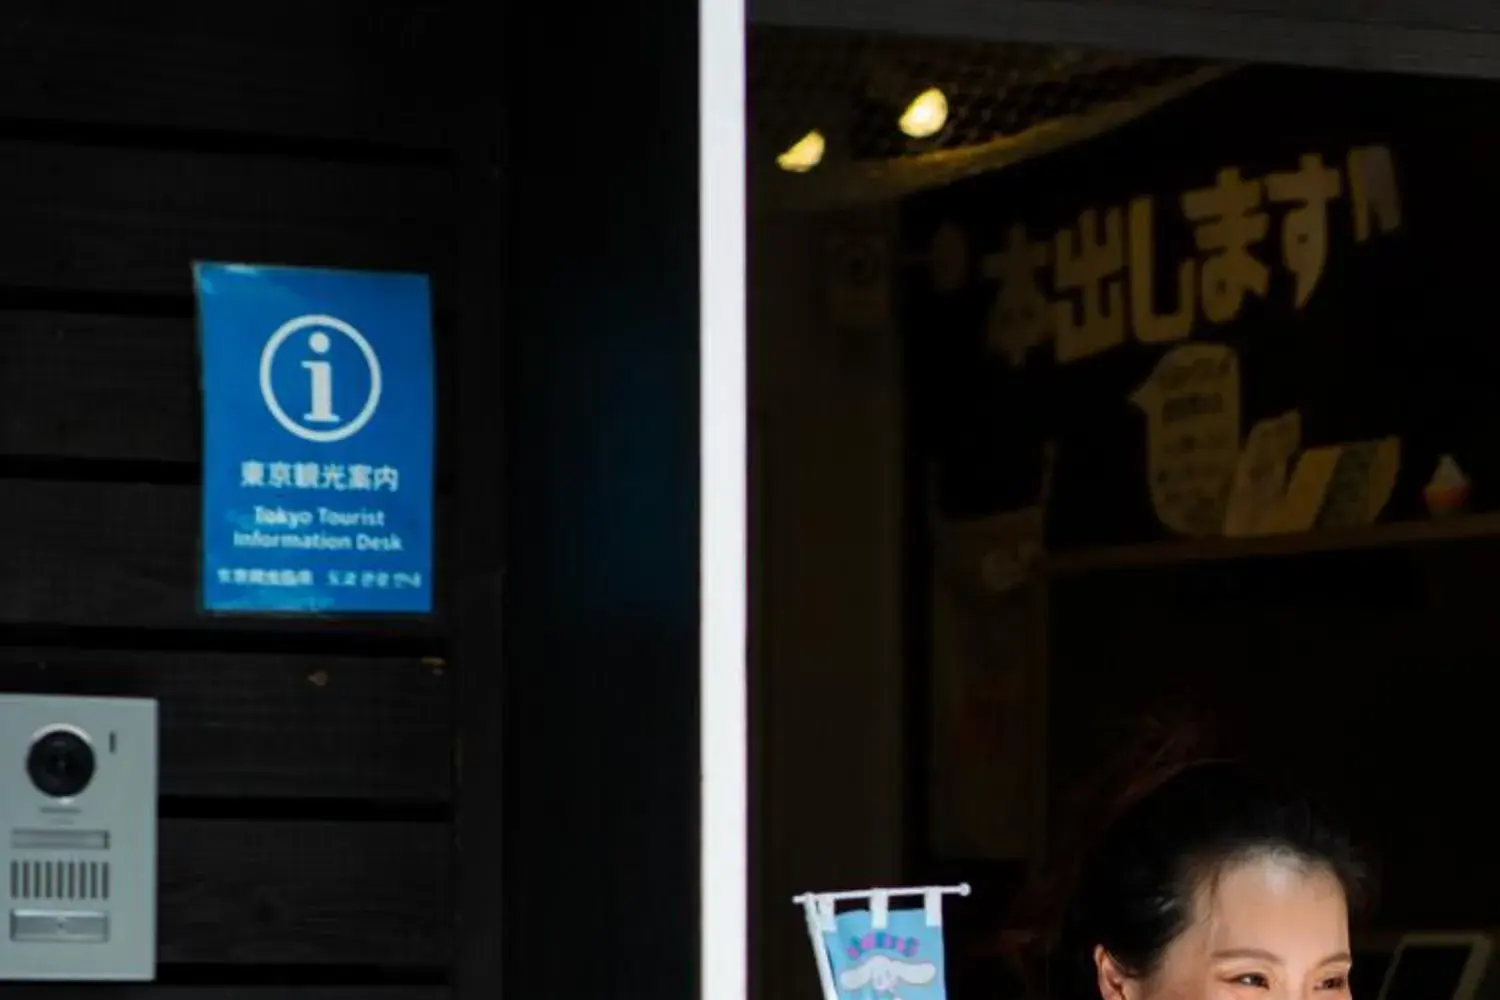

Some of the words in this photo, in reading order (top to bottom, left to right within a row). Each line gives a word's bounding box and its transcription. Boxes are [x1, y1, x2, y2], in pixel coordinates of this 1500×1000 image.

[241, 460, 399, 491] 東京観光案内
[254, 506, 313, 529] Tokyo
[319, 507, 386, 527] Tourist
[234, 530, 352, 549] Information
[356, 533, 404, 551] Desk
